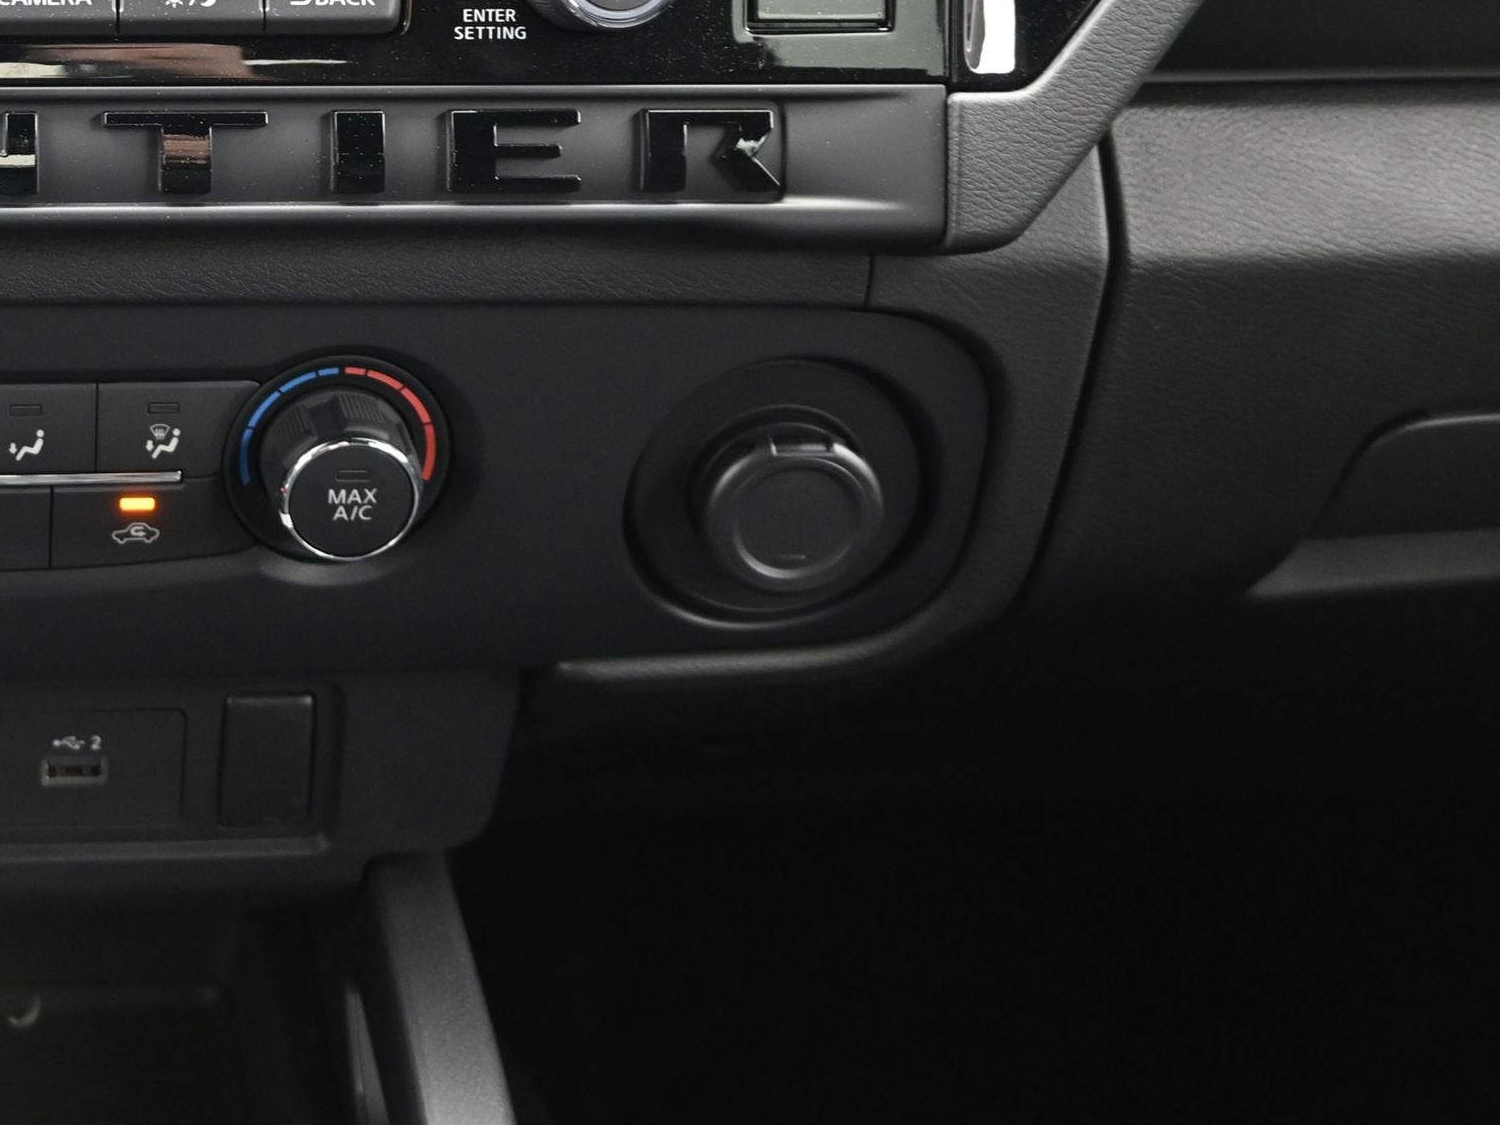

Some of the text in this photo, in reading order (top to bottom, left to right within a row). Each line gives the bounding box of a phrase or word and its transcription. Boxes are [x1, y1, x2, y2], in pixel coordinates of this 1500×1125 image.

[462, 8, 517, 23] ENTER
[453, 26, 527, 41] SETTING
[327, 488, 378, 505] MAX
[332, 505, 373, 521] A/C
[89, 734, 102, 751] 2
